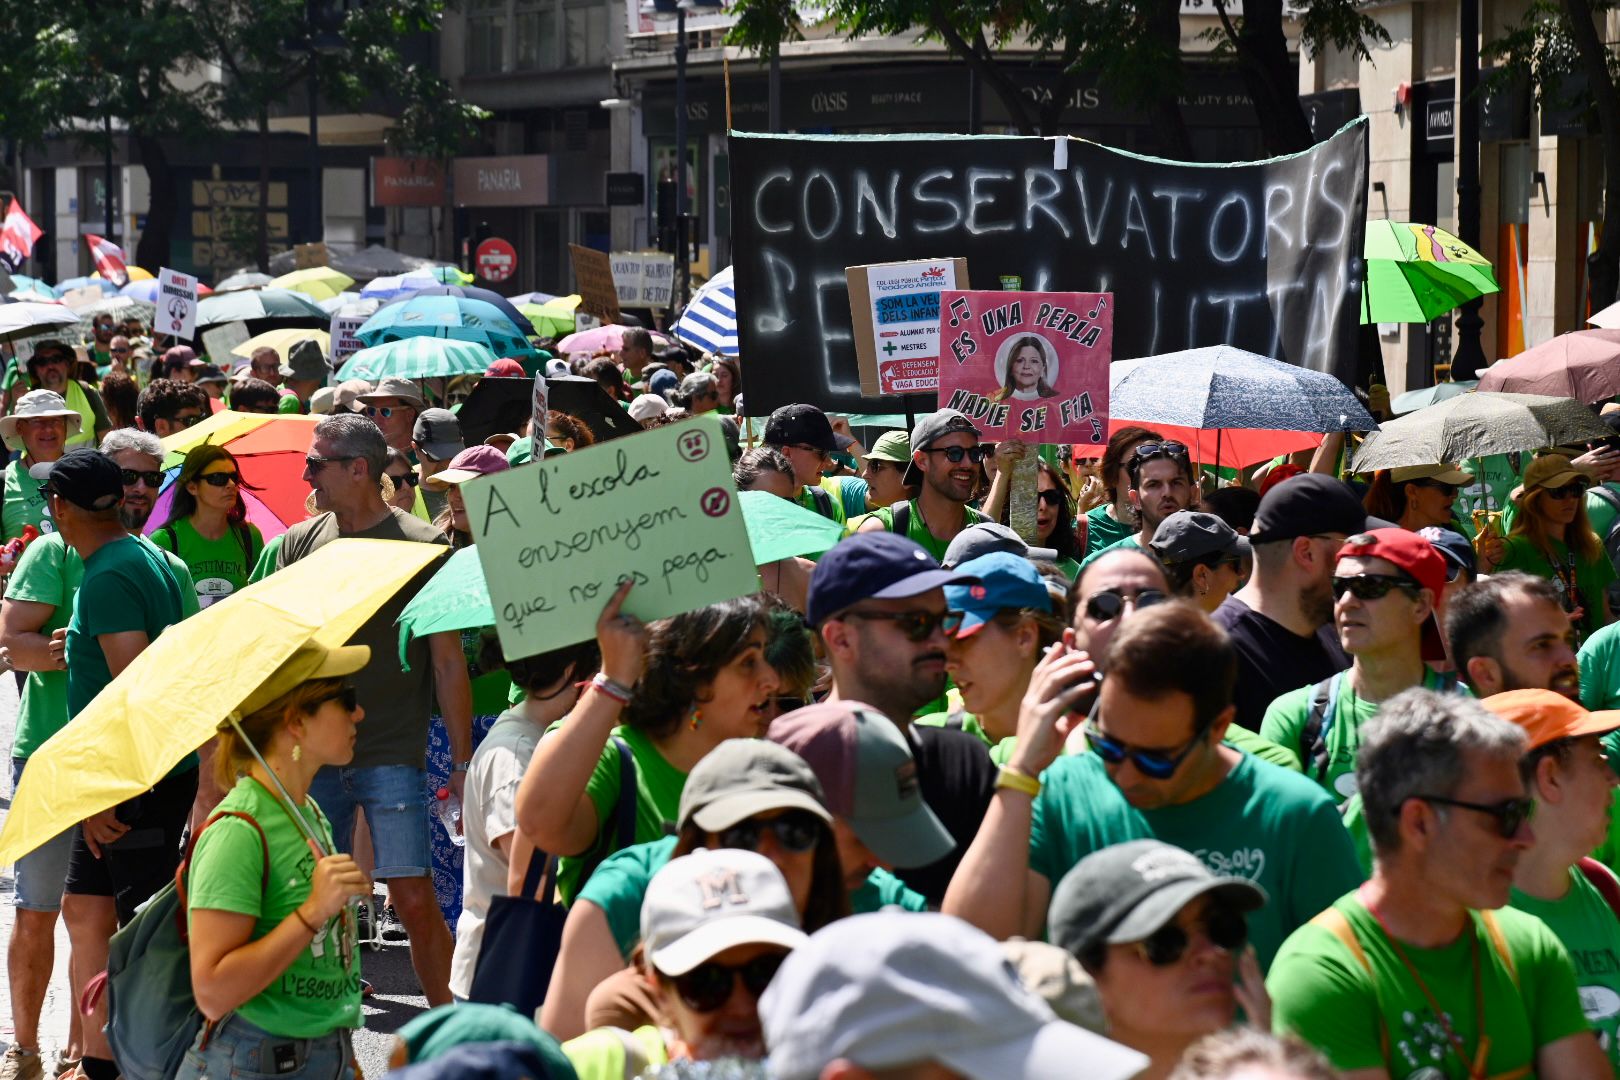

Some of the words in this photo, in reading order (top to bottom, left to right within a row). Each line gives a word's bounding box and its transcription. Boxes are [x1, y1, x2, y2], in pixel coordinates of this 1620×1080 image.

[1429, 110, 1453, 129] AVANZA
[383, 175, 435, 187] PANARIA
[478, 169, 522, 191] PANARIA
[754, 160, 1349, 264] CONSERVATORIS
[876, 283, 915, 291] Teodoro
[915, 280, 947, 288] Andreu
[880, 298, 904, 312] SOM
[906, 296, 920, 308] LA
[882, 310, 908, 323] DELS
[910, 305, 941, 320] INFAN
[900, 327, 924, 337] ALUMNAT
[925, 327, 937, 335] PER
[950, 331, 978, 365] ES
[981, 301, 1023, 336] UNA
[1033, 303, 1103, 349] PERLA
[901, 342, 928, 352] MESTRES
[901, 360, 936, 370] DEFENSEM
[895, 379, 913, 389] VAGA
[915, 377, 940, 387] EDUCA
[946, 388, 1011, 428] NADIE
[1020, 406, 1047, 433] SE
[482, 484, 520, 537] A
[538, 448, 660, 515] l'escola
[518, 505, 688, 569] ensenyem
[503, 595, 556, 636] que
[569, 580, 603, 605] no
[695, 866, 749, 909] M
